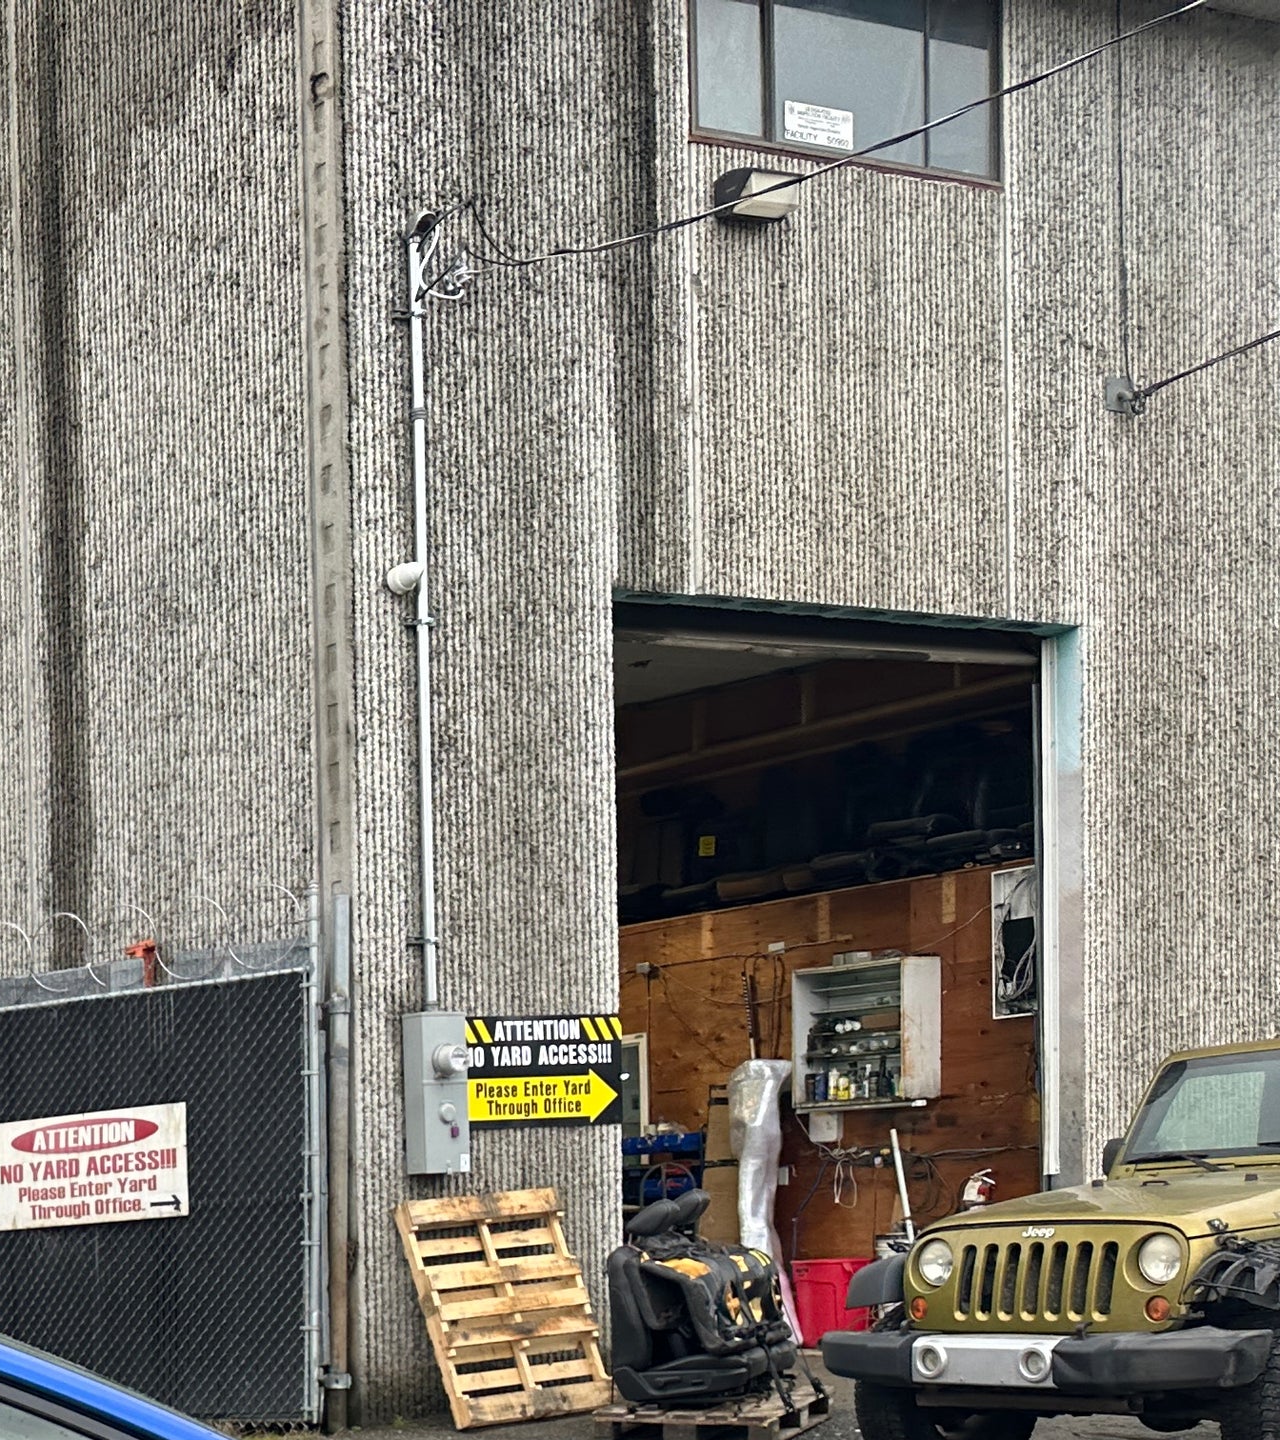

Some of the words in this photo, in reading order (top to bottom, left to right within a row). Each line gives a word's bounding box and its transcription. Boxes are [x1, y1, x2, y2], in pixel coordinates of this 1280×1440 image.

[493, 1018, 581, 1043] ATTENTION
[491, 1045, 532, 1067] YARD
[538, 1043, 613, 1066] ACCESS!!!
[475, 1083, 518, 1099] Please
[523, 1081, 558, 1098] Enter
[563, 1079, 591, 1096] Yard
[486, 1099, 538, 1118] Through
[543, 1097, 582, 1114] Office
[32, 1120, 137, 1152] ATTENTION
[0, 1163, 24, 1186] NO
[29, 1157, 81, 1182] YARD
[86, 1147, 178, 1178] ACCESS!!!
[18, 1185, 67, 1203] Please
[70, 1180, 114, 1198] Enter
[118, 1174, 158, 1194] Yard
[29, 1199, 91, 1222] Through
[1021, 1225, 1055, 1239] Jeep
